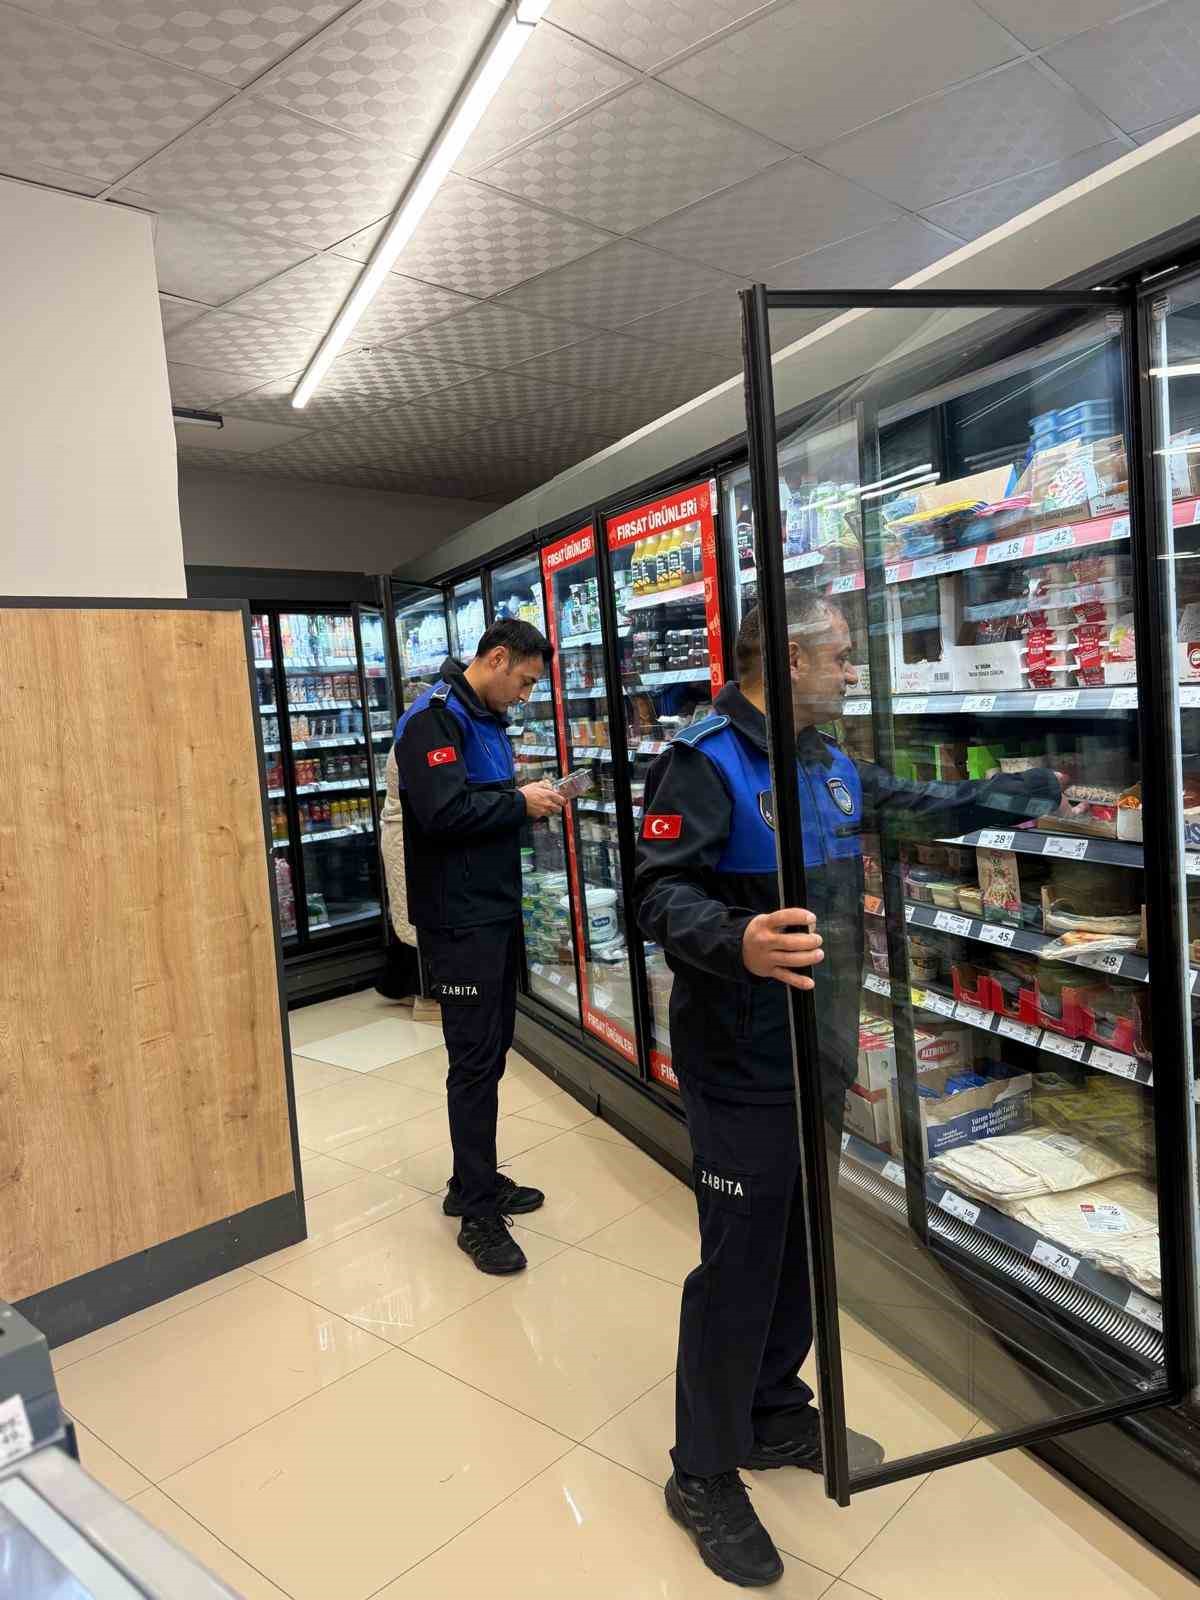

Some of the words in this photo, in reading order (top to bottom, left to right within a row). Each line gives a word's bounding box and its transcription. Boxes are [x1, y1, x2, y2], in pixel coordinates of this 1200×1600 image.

[616, 517, 648, 541] FIRSAT
[648, 498, 698, 530] ÜRÜNLERİ
[547, 549, 564, 568] FIRSAT
[441, 985, 479, 996] ZABITA
[701, 1170, 744, 1197] ZABITA
[1054, 1253, 1070, 1267] 70
